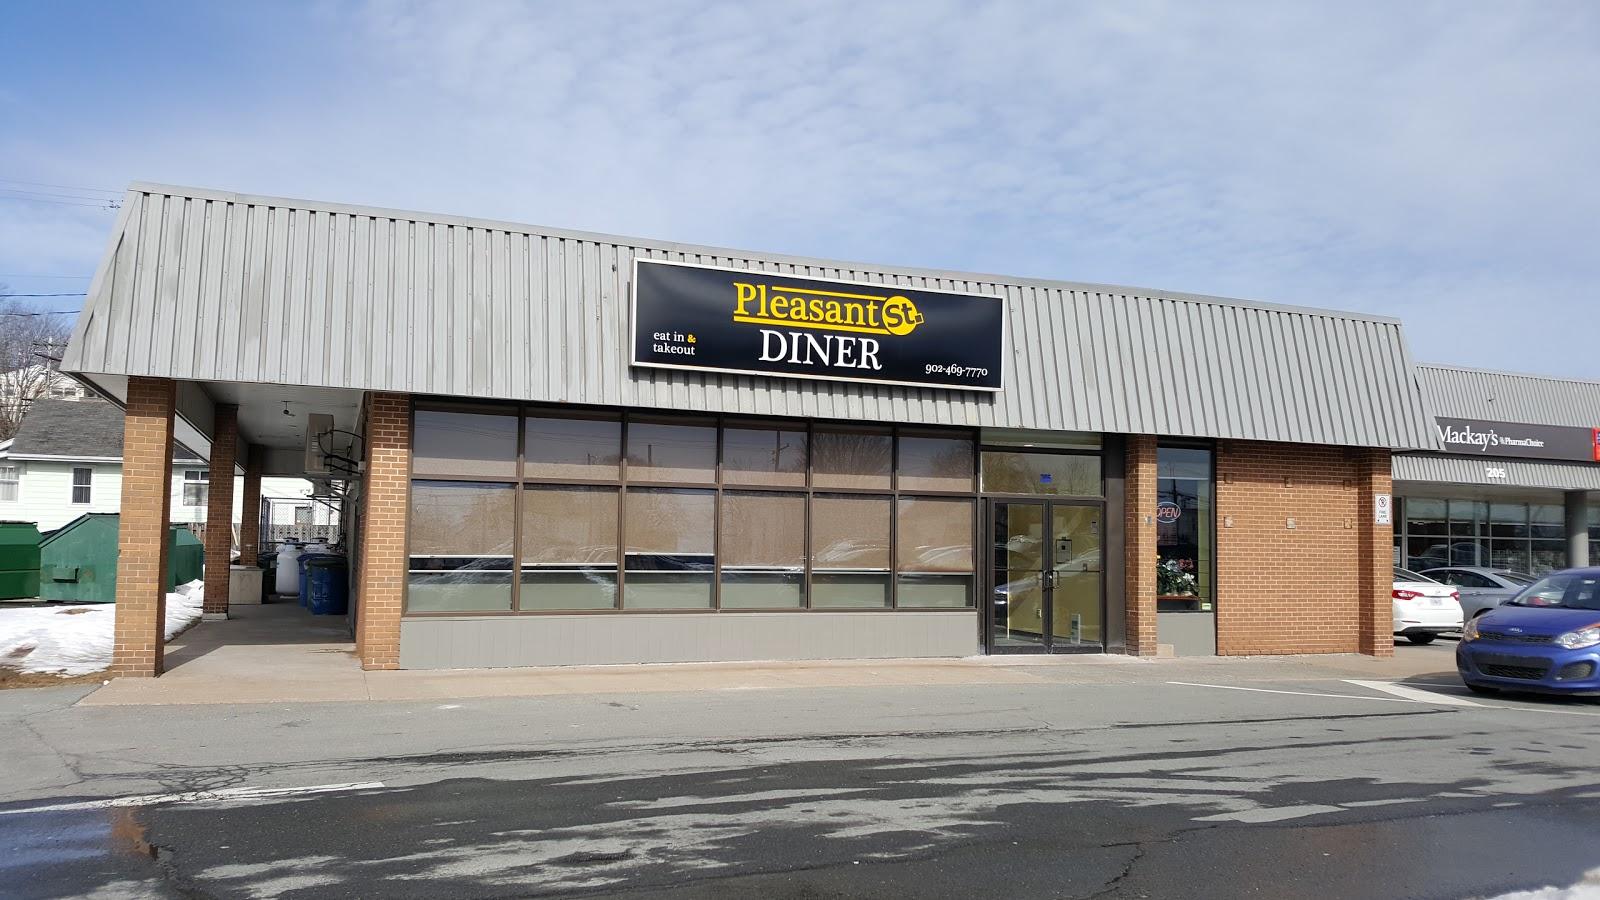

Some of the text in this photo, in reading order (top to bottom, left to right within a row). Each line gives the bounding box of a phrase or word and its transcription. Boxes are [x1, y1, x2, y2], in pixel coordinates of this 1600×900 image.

[733, 283, 879, 327] Pleasant
[653, 331, 697, 343] eat in &
[653, 342, 696, 356] takeout
[758, 329, 882, 370] DINER
[925, 364, 988, 378] 902-469-7770
[1437, 425, 1498, 451] Mackay's
[1486, 467, 1506, 478] 205
